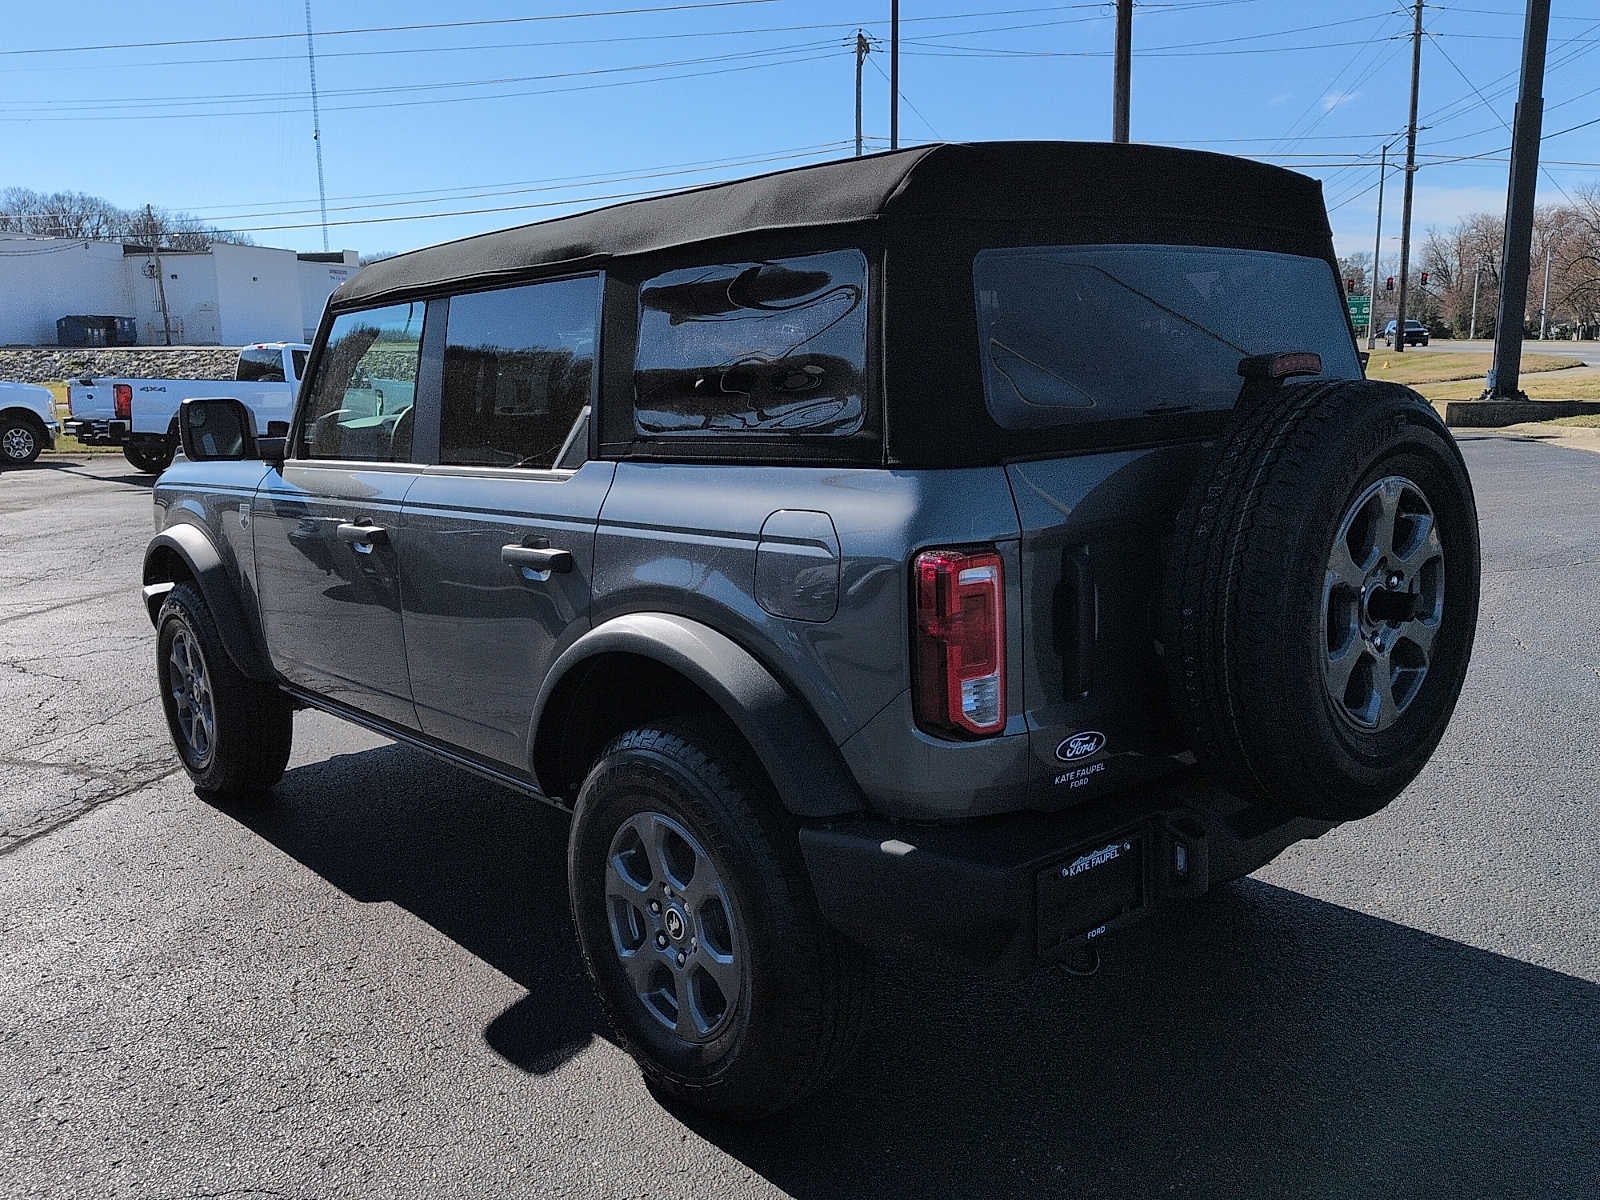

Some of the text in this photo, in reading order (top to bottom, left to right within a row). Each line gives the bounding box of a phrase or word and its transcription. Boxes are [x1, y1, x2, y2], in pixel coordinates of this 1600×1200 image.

[1066, 736, 1097, 757] Ford
[1055, 762, 1105, 785] KATE FAUPEL
[1070, 777, 1089, 789] FORD
[1069, 849, 1120, 877] KATE FAUPEL
[1087, 925, 1106, 940] FORD
